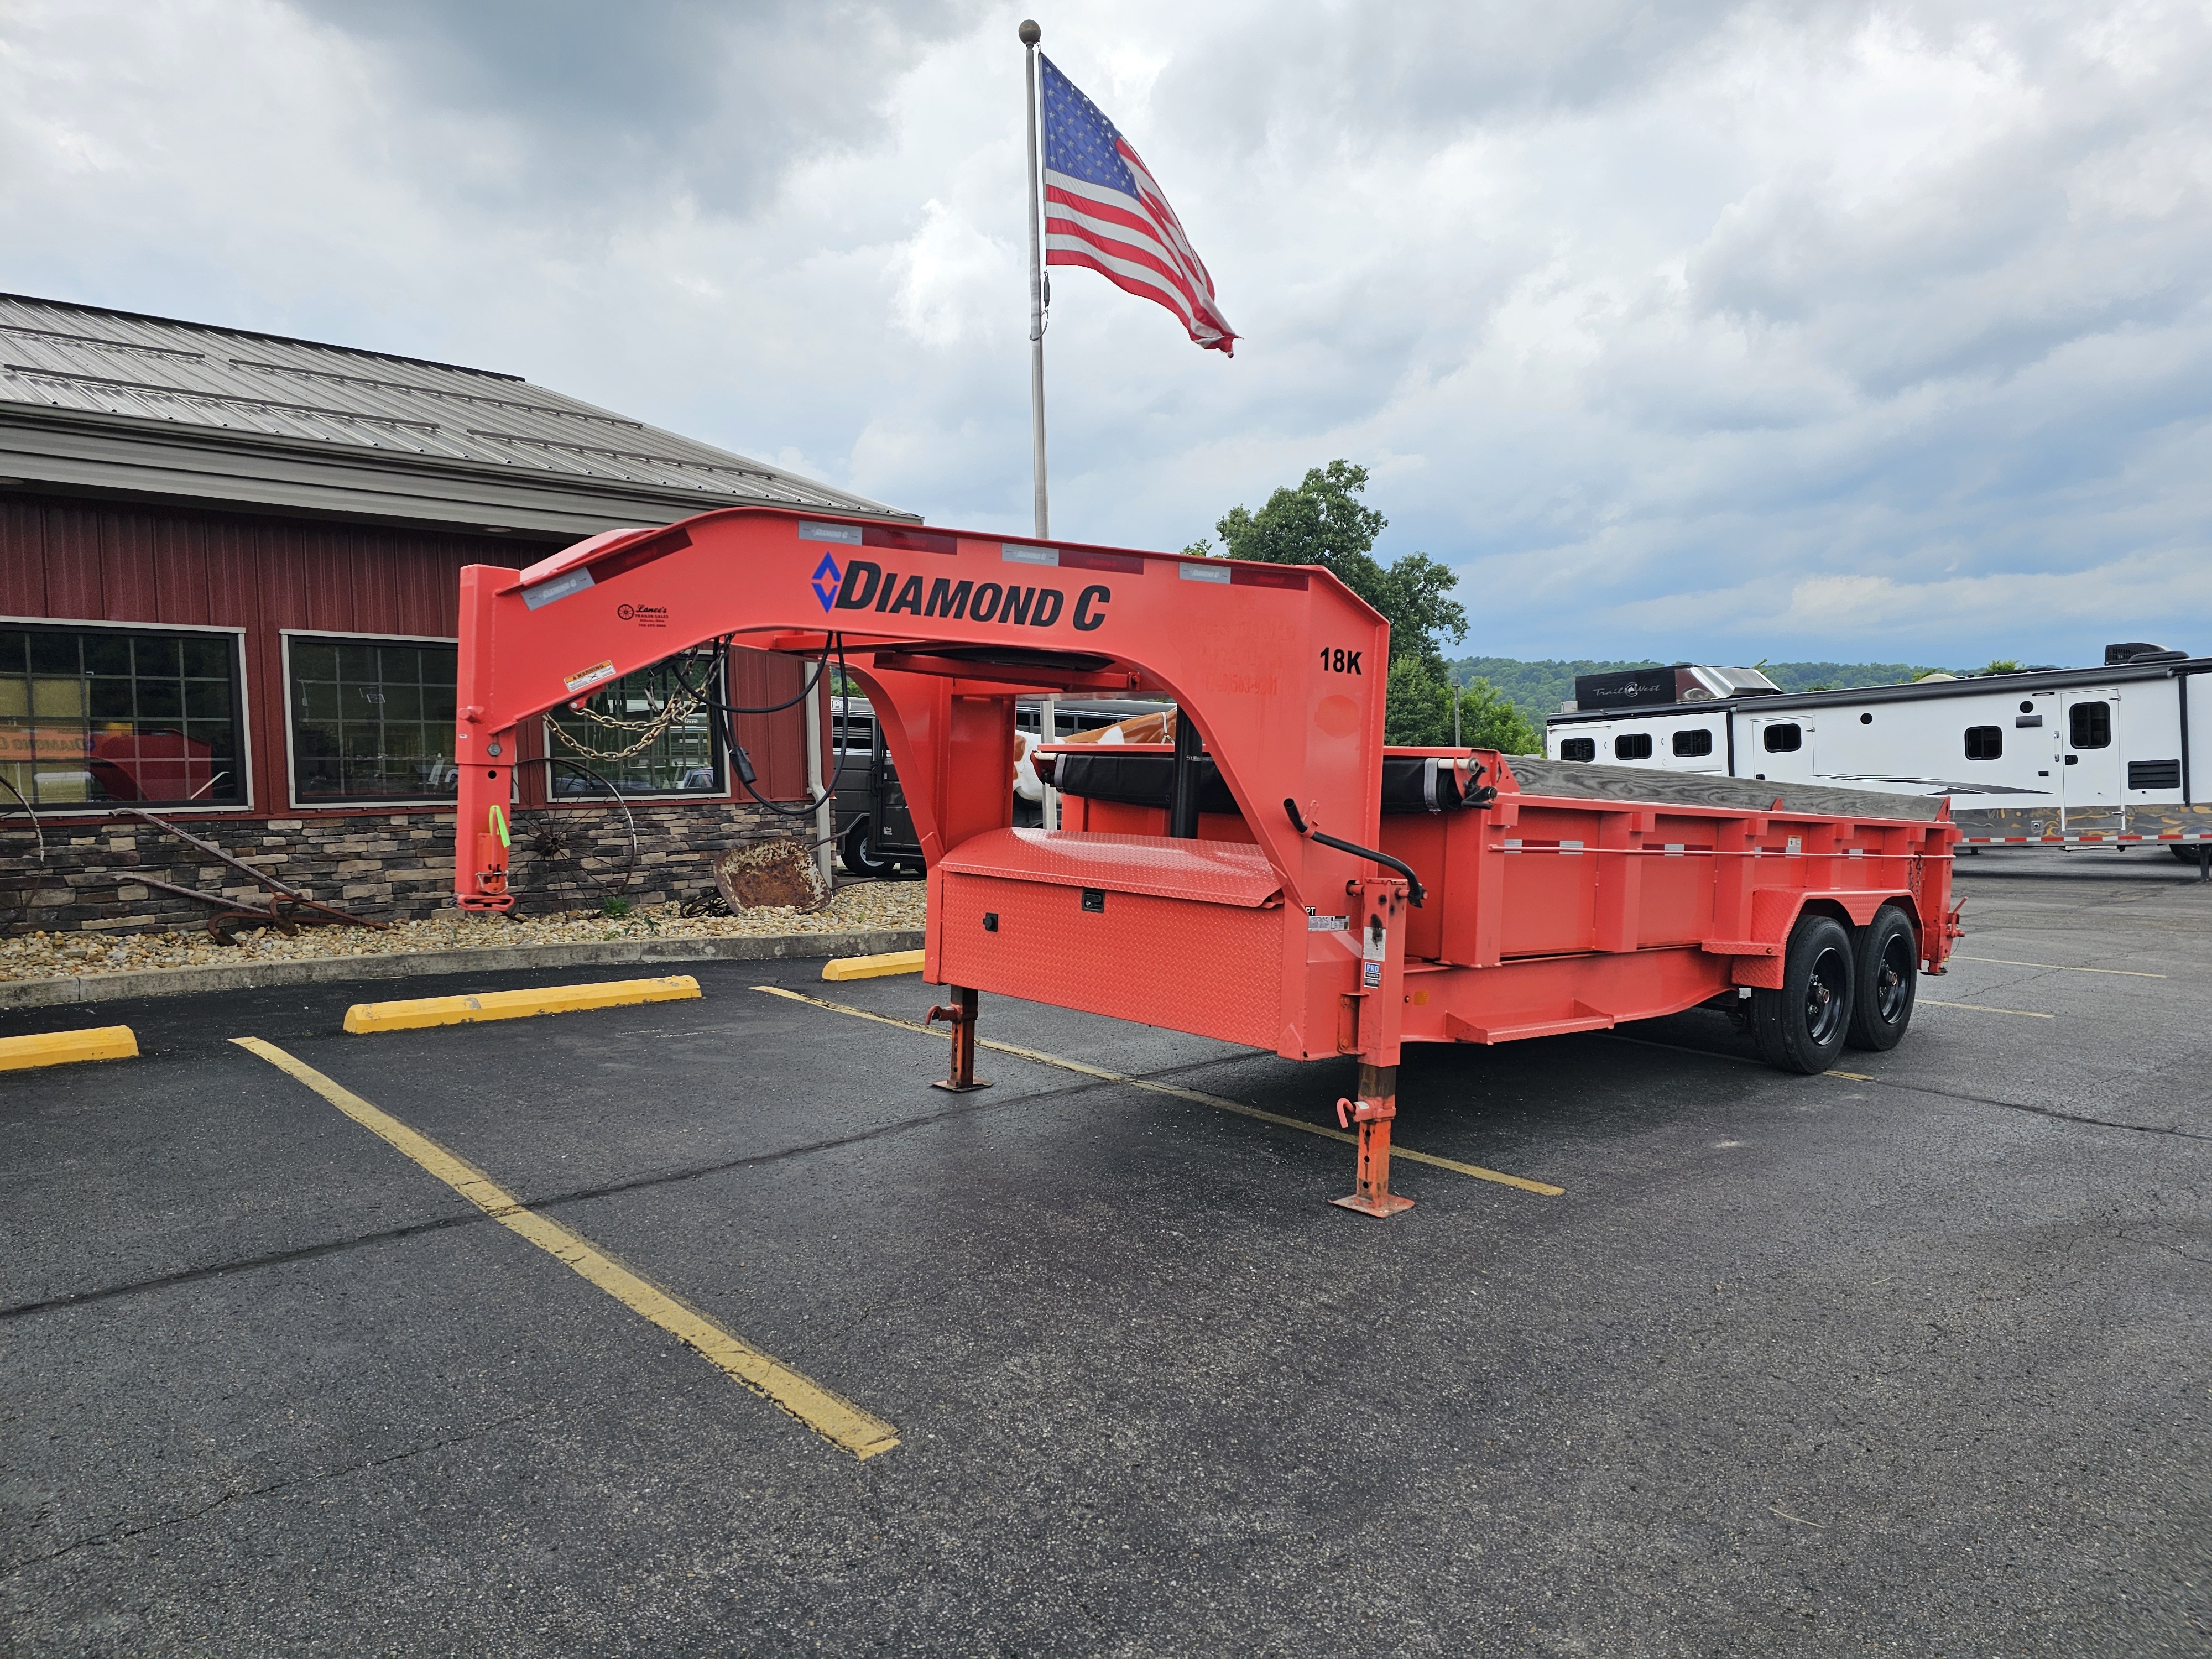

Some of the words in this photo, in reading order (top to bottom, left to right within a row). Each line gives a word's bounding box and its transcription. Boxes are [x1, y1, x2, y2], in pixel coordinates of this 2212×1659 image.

[834, 560, 1064, 627] DIAMOND
[1073, 585, 1110, 631] C
[635, 604, 667, 613] Lance's
[1321, 646, 1363, 675] 18K
[577, 664, 604, 679] WARNING
[1593, 687, 1626, 696] Trail
[1366, 964, 1379, 973] PRO
